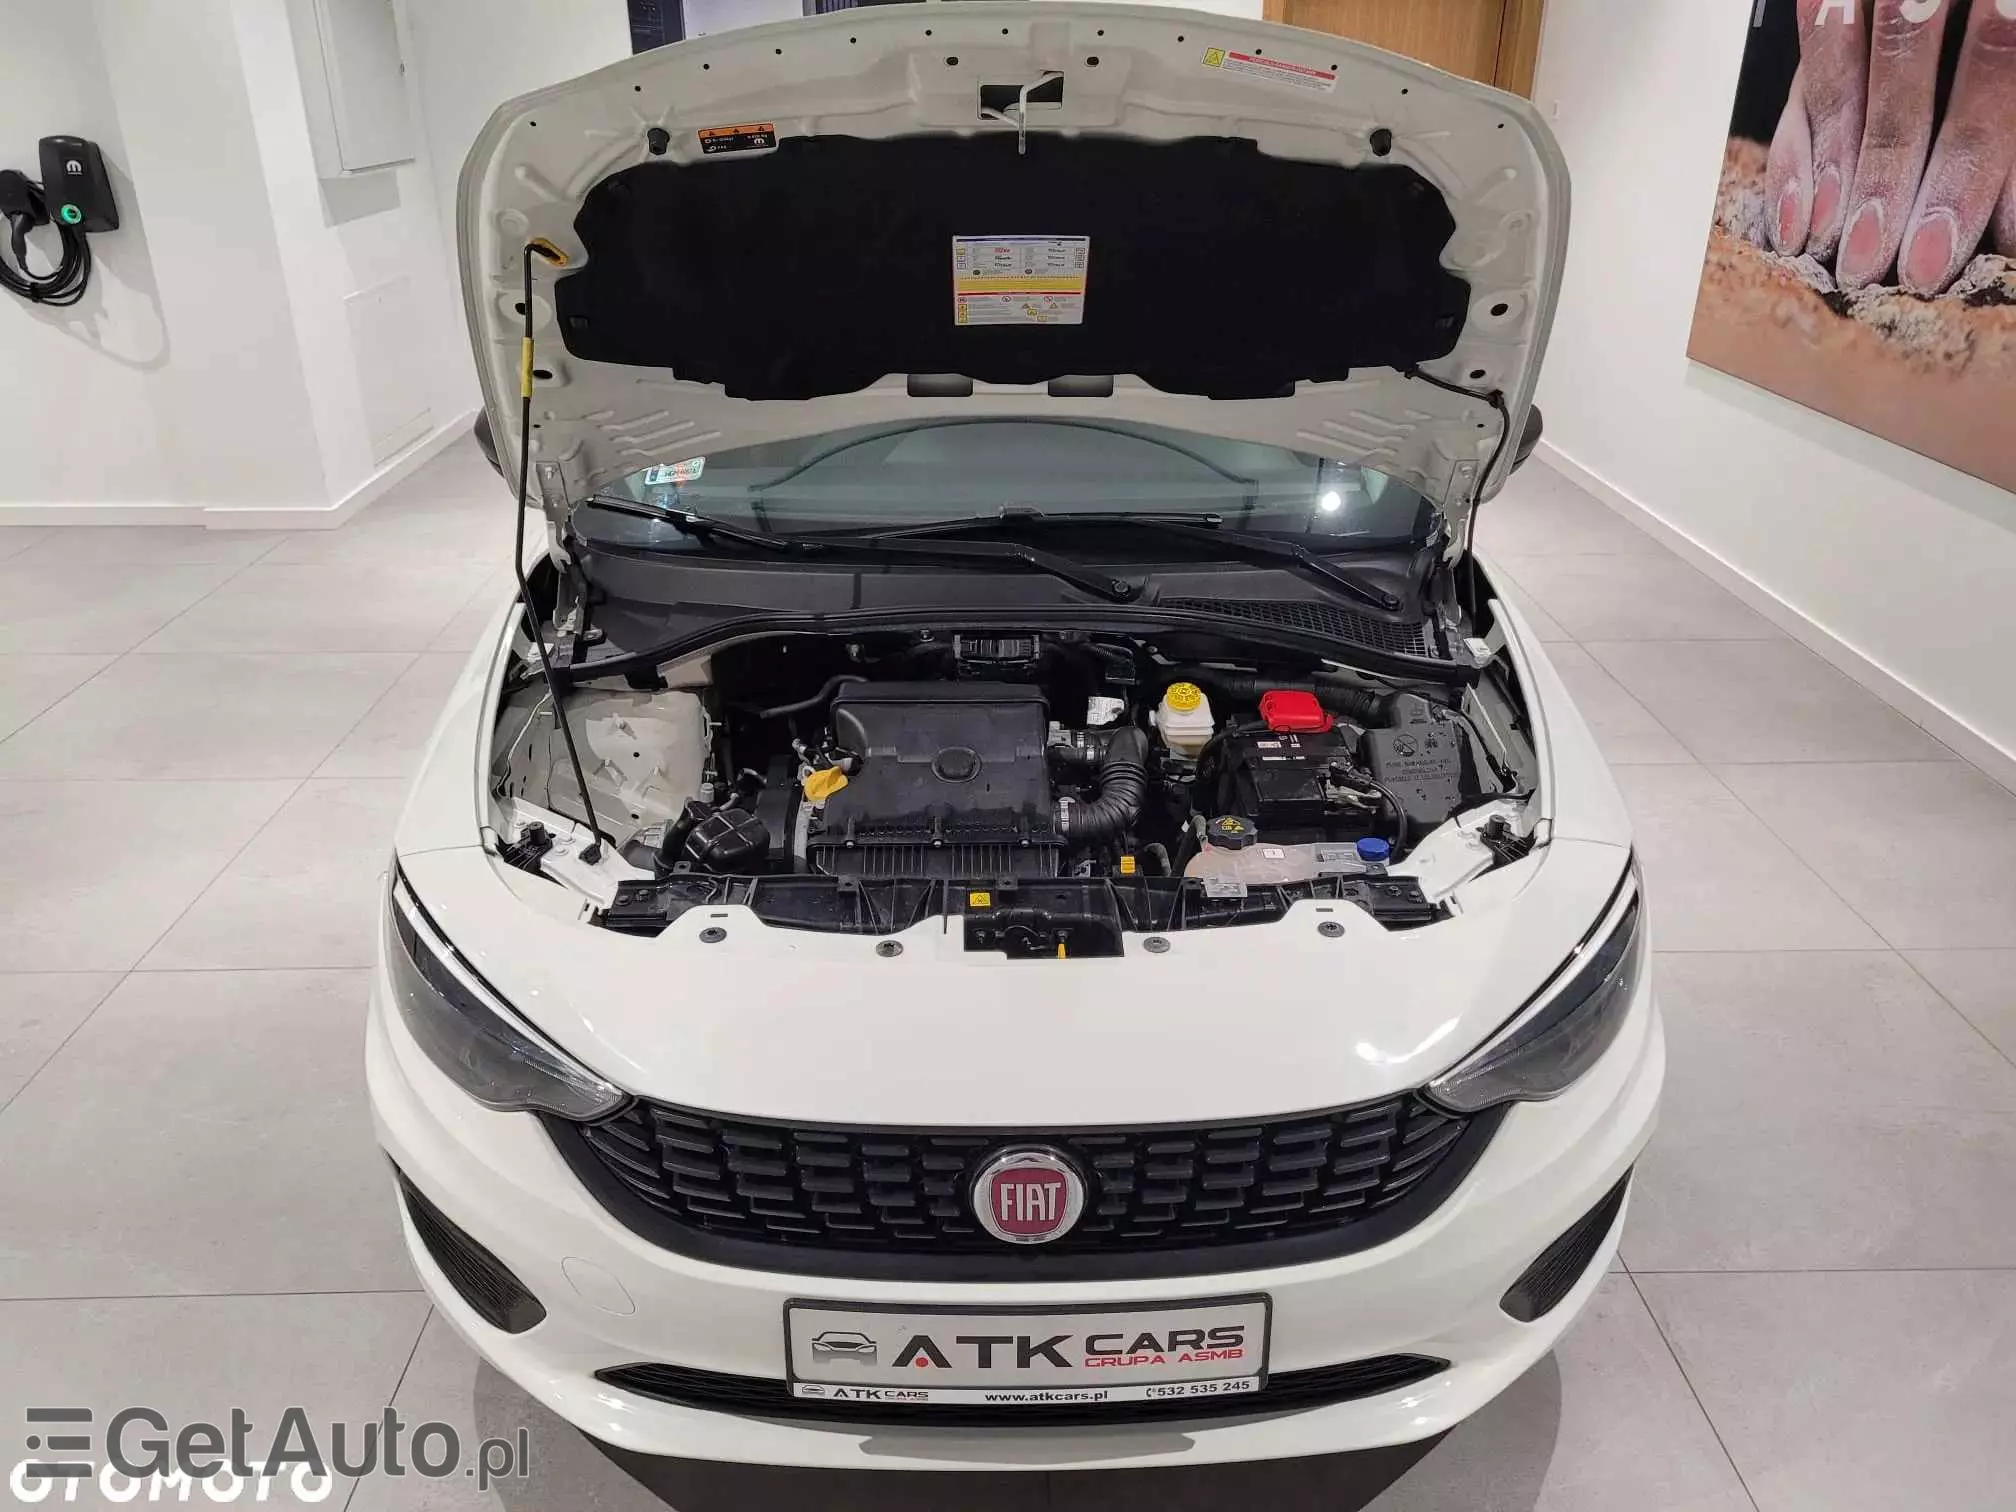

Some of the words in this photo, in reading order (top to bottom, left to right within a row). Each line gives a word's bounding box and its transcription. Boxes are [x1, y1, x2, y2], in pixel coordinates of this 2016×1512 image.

[1001, 1182, 1061, 1221] FIAT
[892, 1334, 1073, 1369] ATK
[1085, 1325, 1245, 1355] CARS
[1084, 1354, 1165, 1368] GRUPA
[1177, 1349, 1243, 1362] ASMB
[833, 1388, 881, 1399] ATK
[884, 1390, 929, 1398] CARS
[985, 1390, 1108, 1402] www.atkcars.pl
[1157, 1386, 1185, 1396] 532
[1191, 1383, 1217, 1394] 535
[1223, 1380, 1250, 1391] 245
